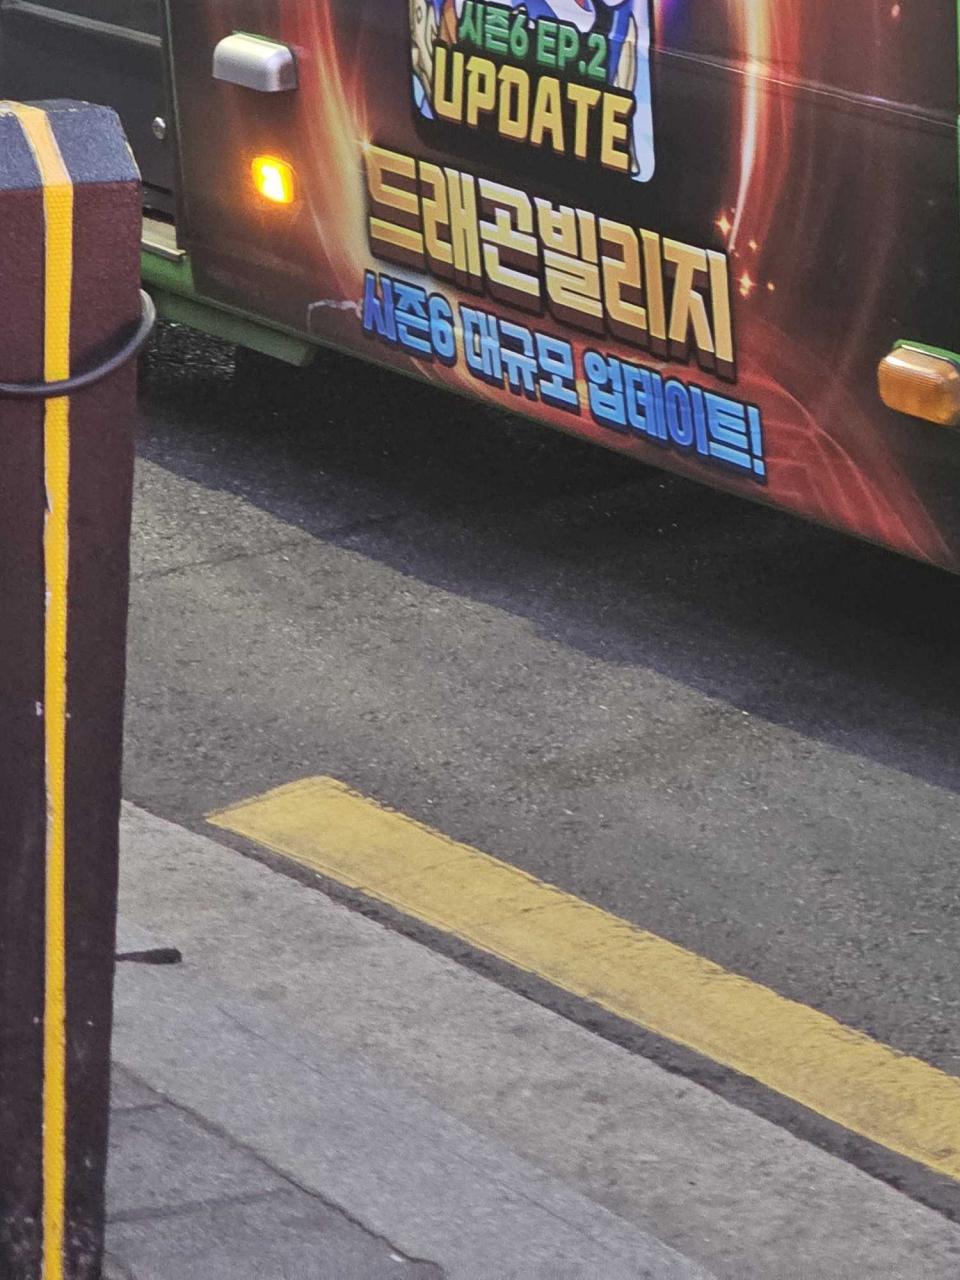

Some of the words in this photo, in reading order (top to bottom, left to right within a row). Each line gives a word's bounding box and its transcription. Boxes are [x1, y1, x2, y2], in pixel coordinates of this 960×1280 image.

[432, 47, 636, 171] UPDATE
[536, 11, 609, 80] EP.2
[364, 145, 737, 375] 드래곤빌리지
[362, 271, 456, 362] 시즌6
[460, 306, 580, 411] 대규모
[583, 349, 767, 481] 업데이트!
